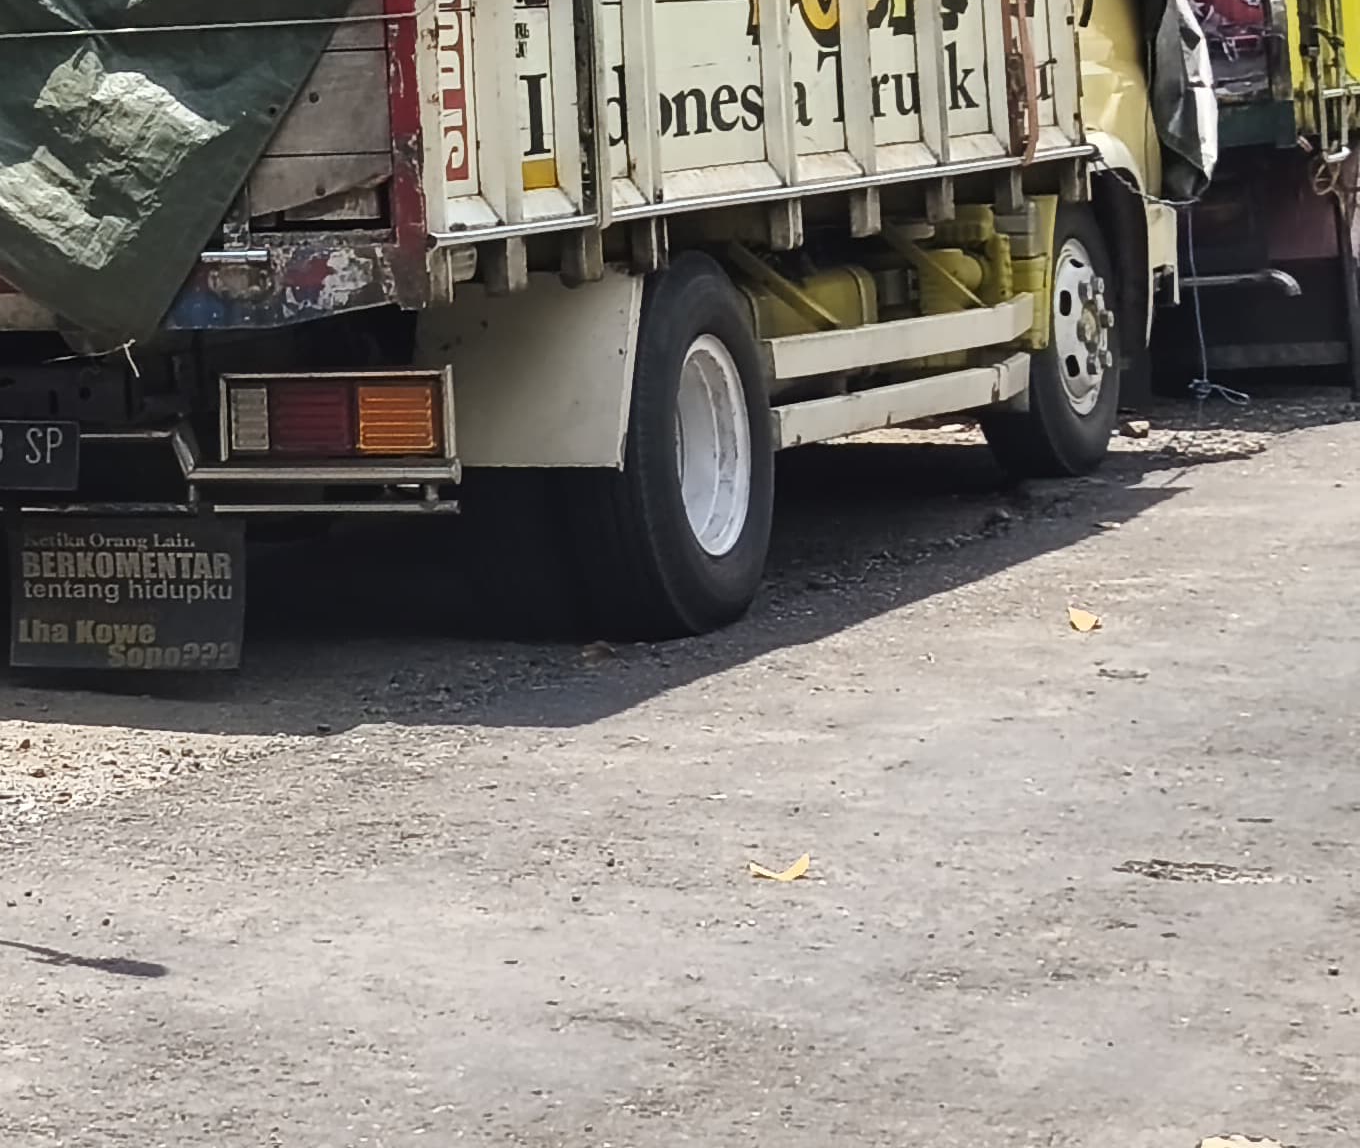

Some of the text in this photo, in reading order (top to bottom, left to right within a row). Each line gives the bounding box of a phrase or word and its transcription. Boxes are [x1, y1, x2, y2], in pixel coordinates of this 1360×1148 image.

[25, 426, 64, 465] SP
[88, 531, 149, 552] Orang
[21, 551, 233, 580] BERKOMENTAR
[23, 579, 233, 605] tentang hidupku
[18, 619, 157, 645] Lha Kowe
